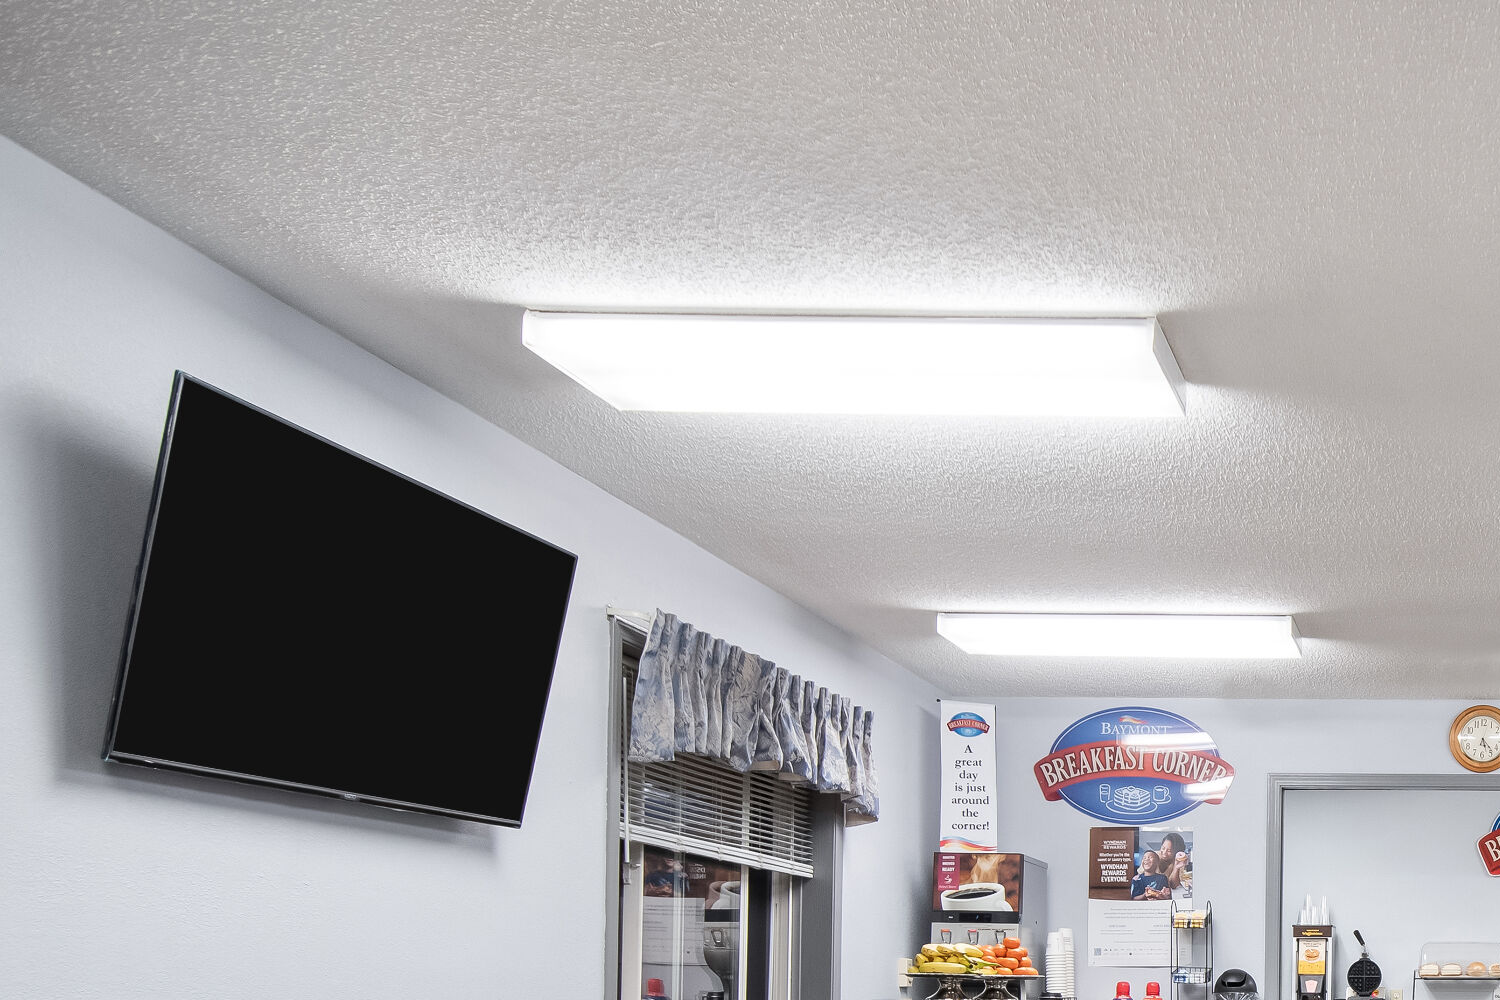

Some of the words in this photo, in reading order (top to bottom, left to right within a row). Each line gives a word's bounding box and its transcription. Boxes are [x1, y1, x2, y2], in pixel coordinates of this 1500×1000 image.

[1474, 720, 1480, 728] 11
[1480, 718, 1488, 727] 12
[1100, 722, 1169, 735] BAYMONT
[1467, 726, 1474, 735] 10
[964, 744, 973, 754] A
[954, 759, 982, 769] great
[1039, 744, 1146, 788] BREAKFAST
[958, 769, 979, 783] day
[954, 782, 964, 792] is
[966, 782, 986, 795] just
[951, 795, 990, 805] around
[961, 808, 979, 818] the
[951, 821, 990, 831] corner!
